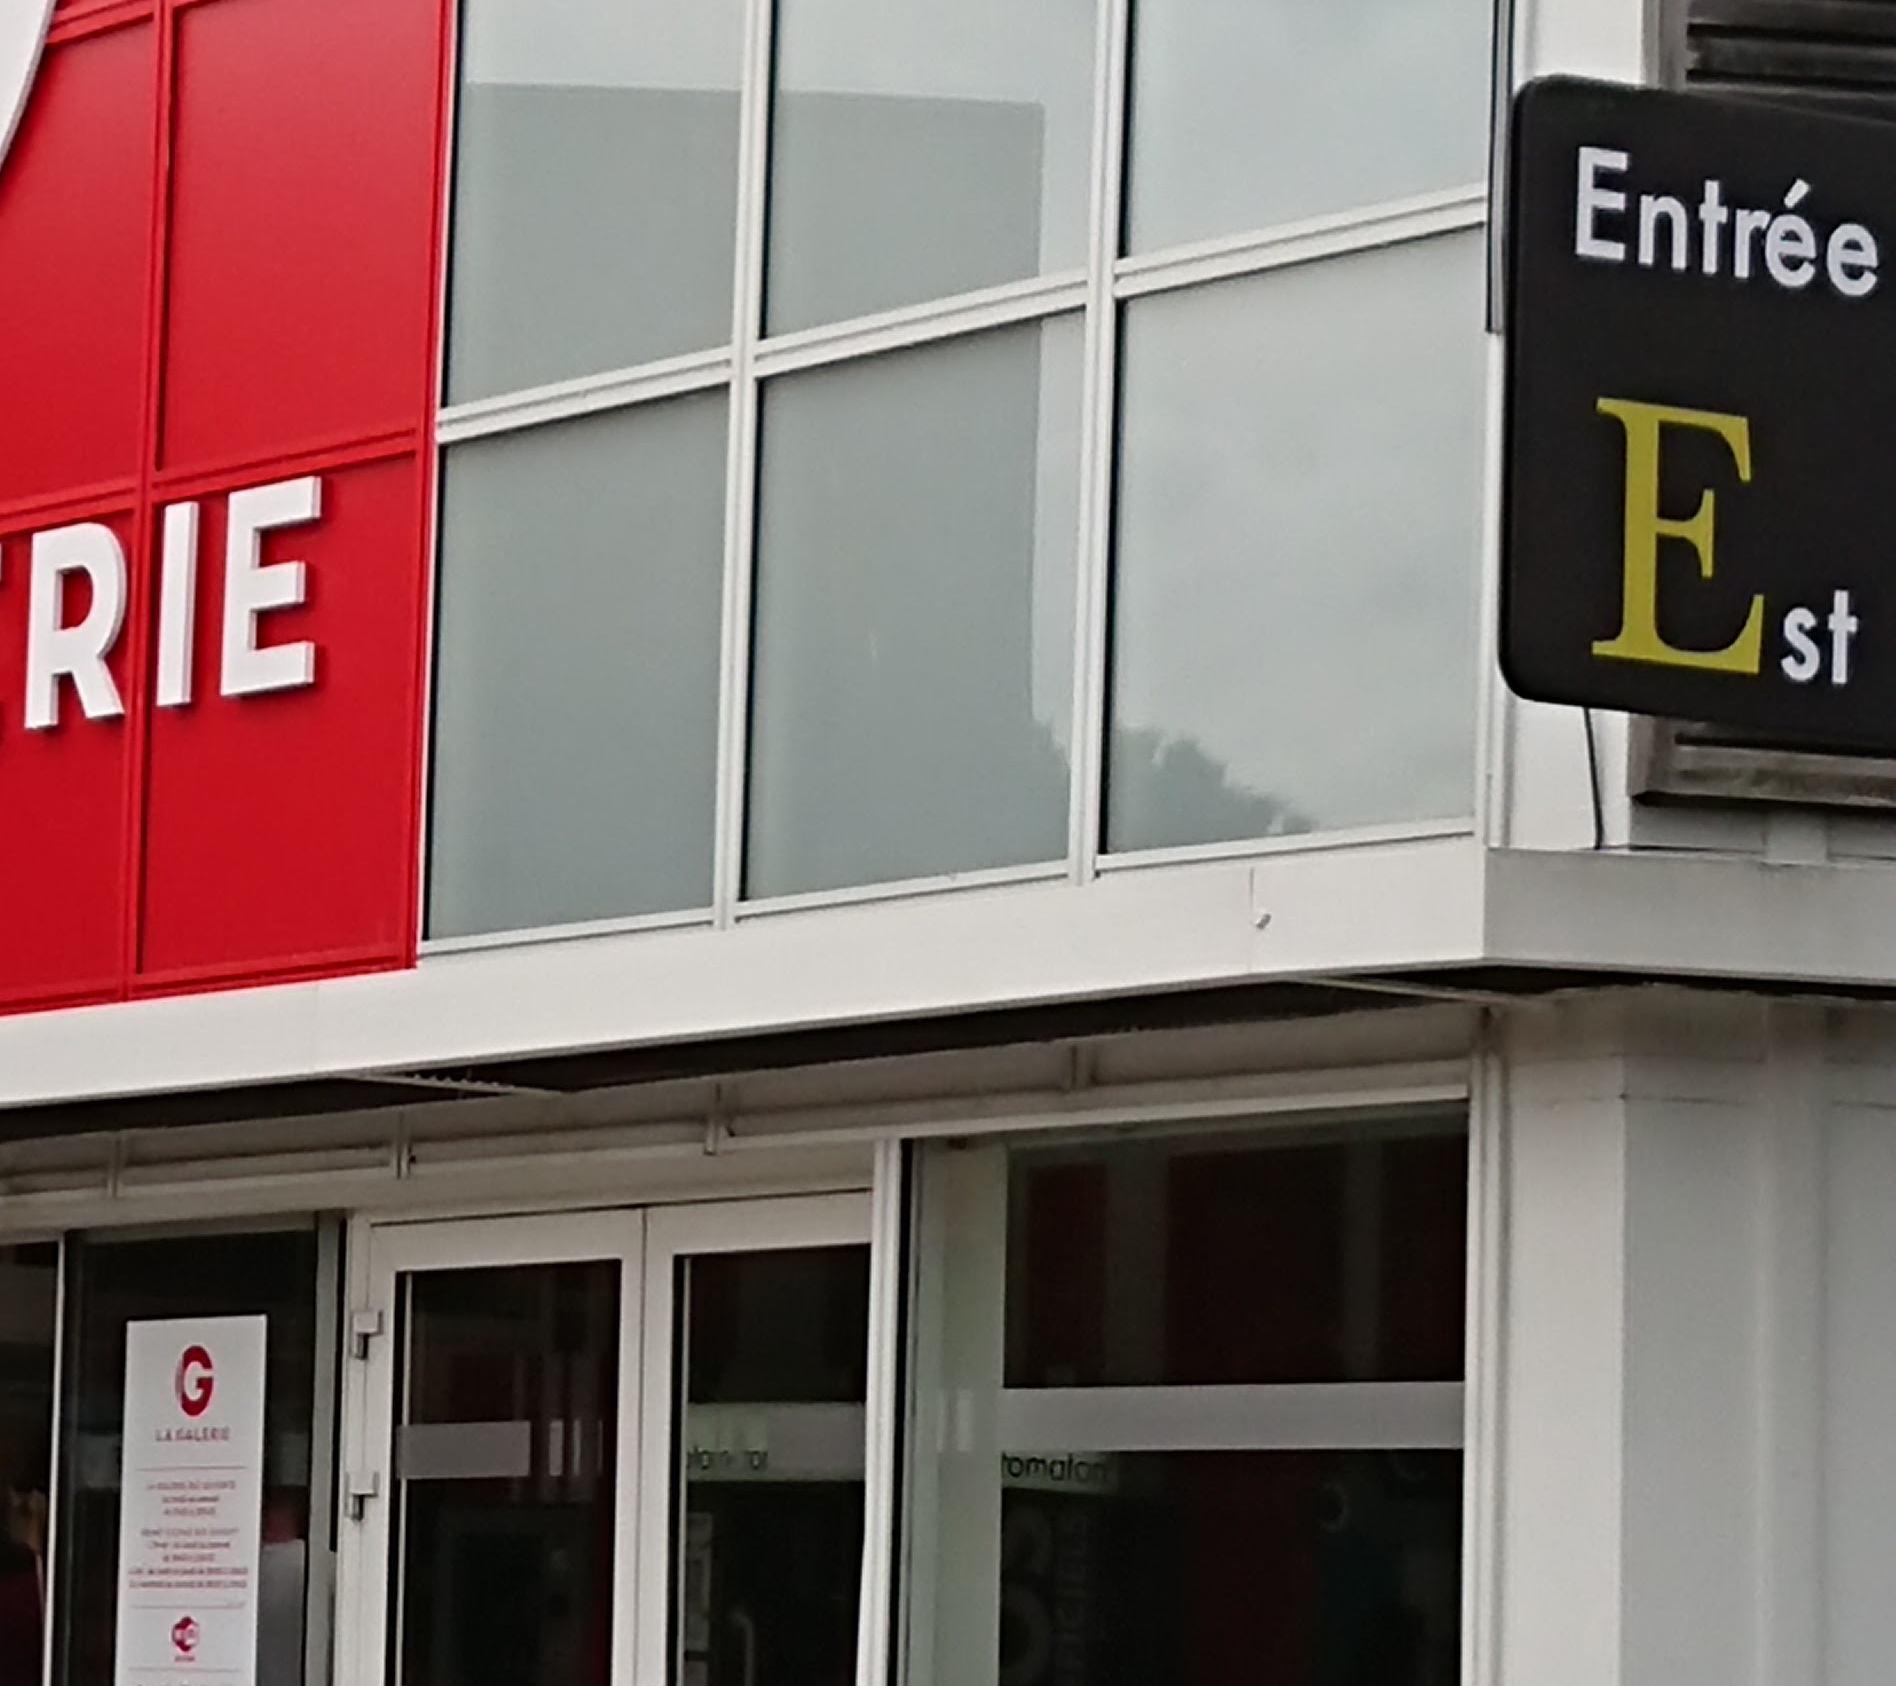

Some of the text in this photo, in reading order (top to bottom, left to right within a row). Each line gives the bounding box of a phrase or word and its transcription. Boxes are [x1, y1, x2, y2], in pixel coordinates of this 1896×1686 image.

[1575, 145, 1880, 297] Entrée
[1591, 396, 1860, 685] Est
[175, 1344, 214, 1417] G
